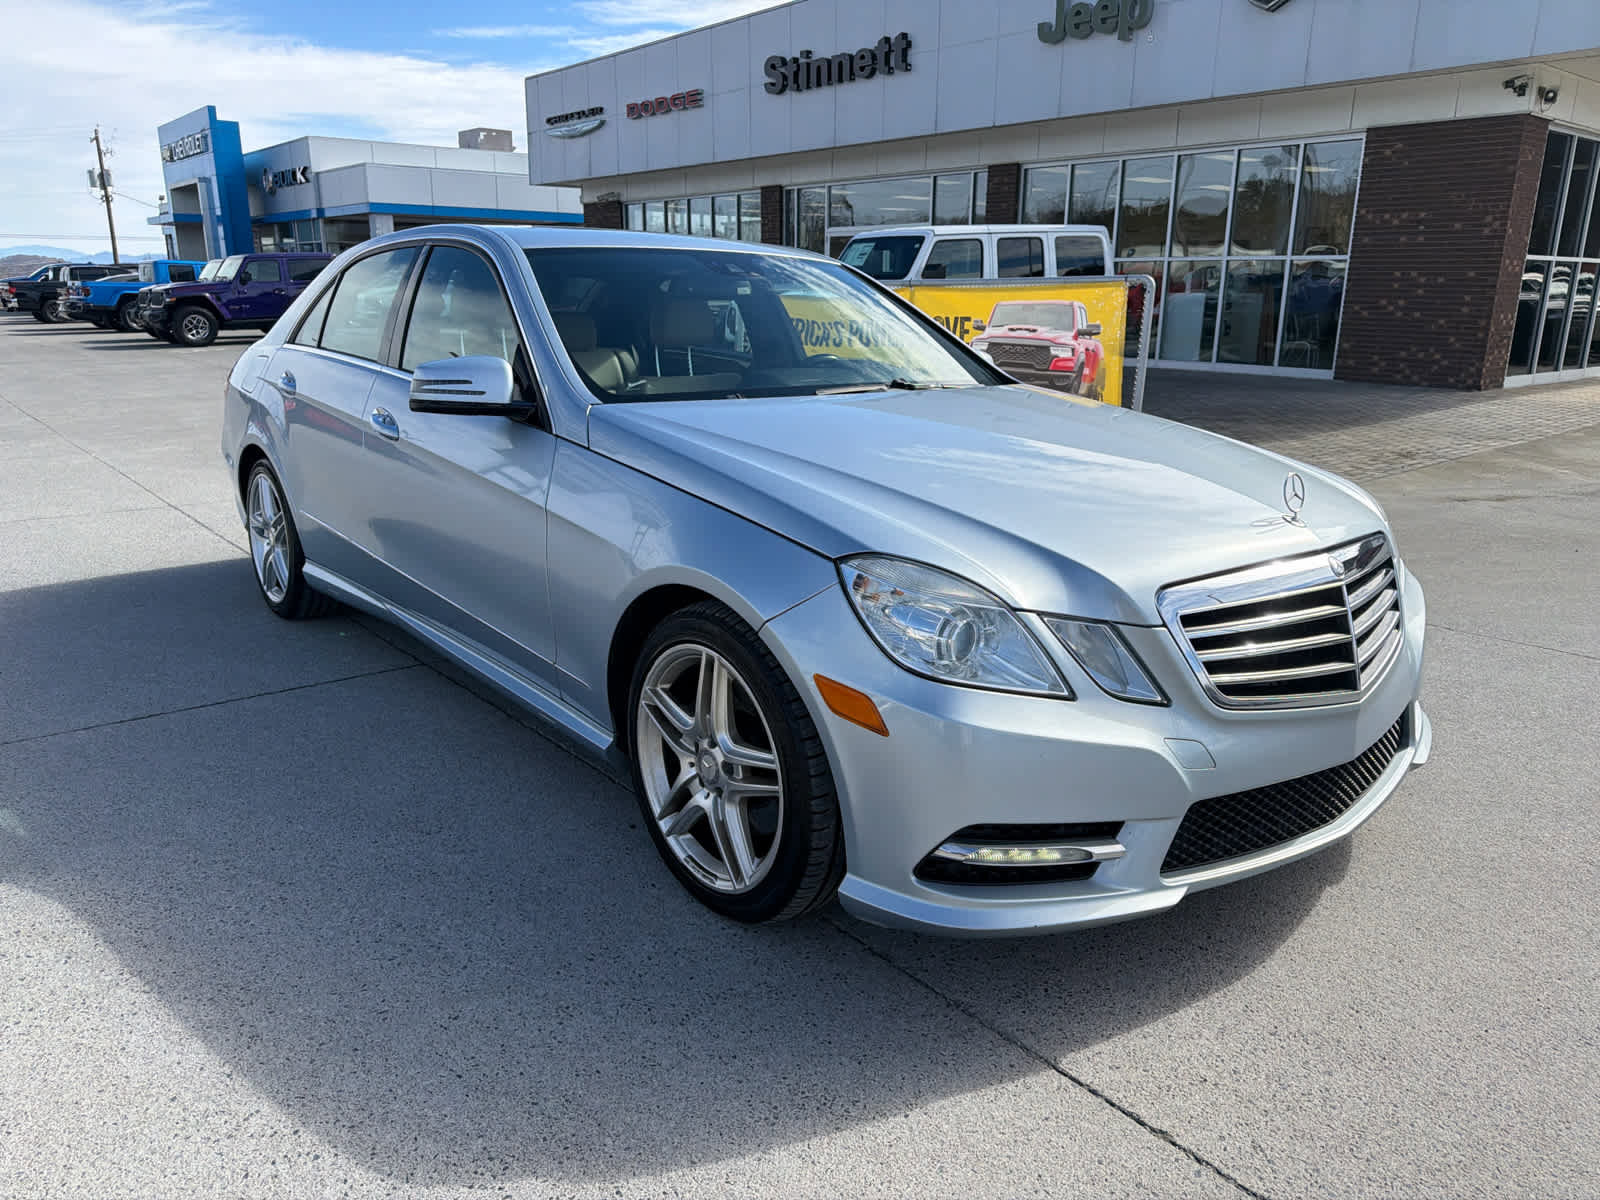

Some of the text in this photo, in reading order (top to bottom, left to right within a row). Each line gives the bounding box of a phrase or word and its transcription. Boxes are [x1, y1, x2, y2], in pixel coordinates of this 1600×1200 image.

[1038, 0, 1154, 45] Jeep
[764, 32, 912, 95] Stinnett
[626, 89, 704, 119] DODGE
[272, 166, 309, 187] BUICK
